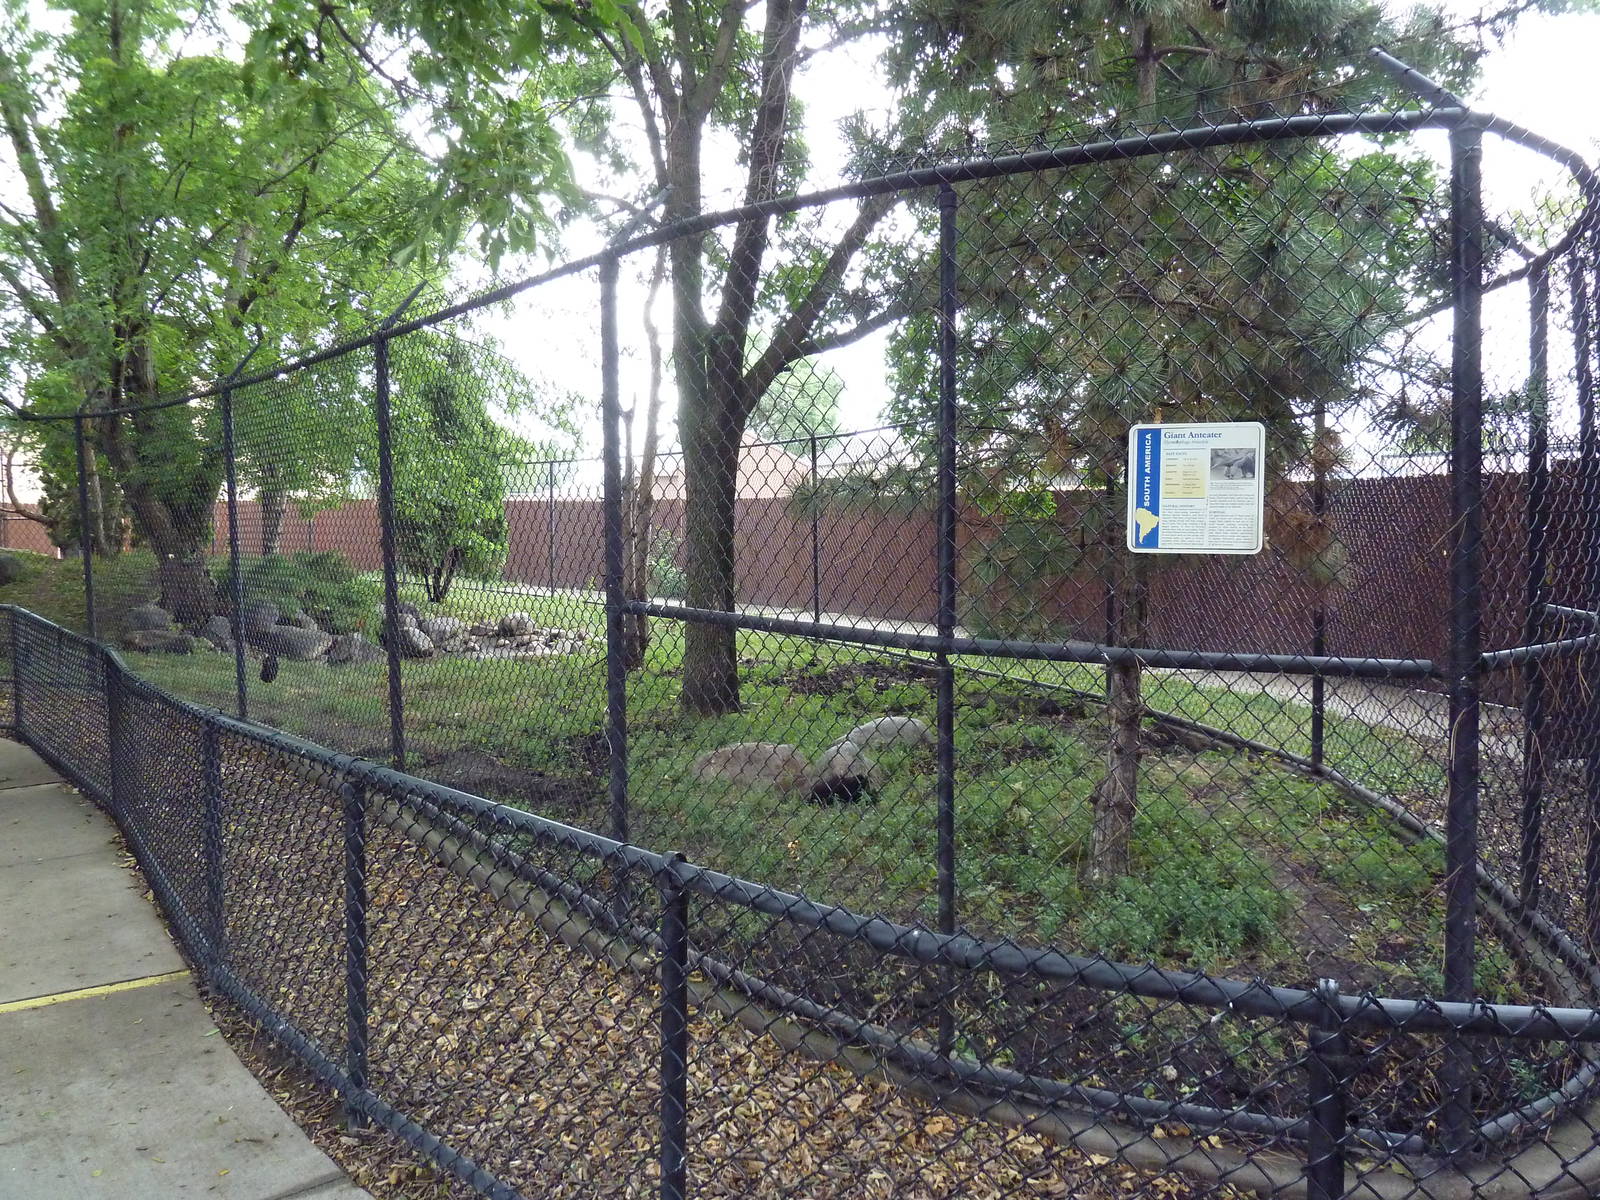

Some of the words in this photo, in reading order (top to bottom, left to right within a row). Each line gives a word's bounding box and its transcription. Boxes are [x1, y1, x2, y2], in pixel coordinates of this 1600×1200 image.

[1164, 431, 1186, 439] Giant
[1188, 431, 1222, 439] Anteater
[1144, 433, 1152, 474] AMERICA
[1143, 476, 1151, 507] SOUTH
